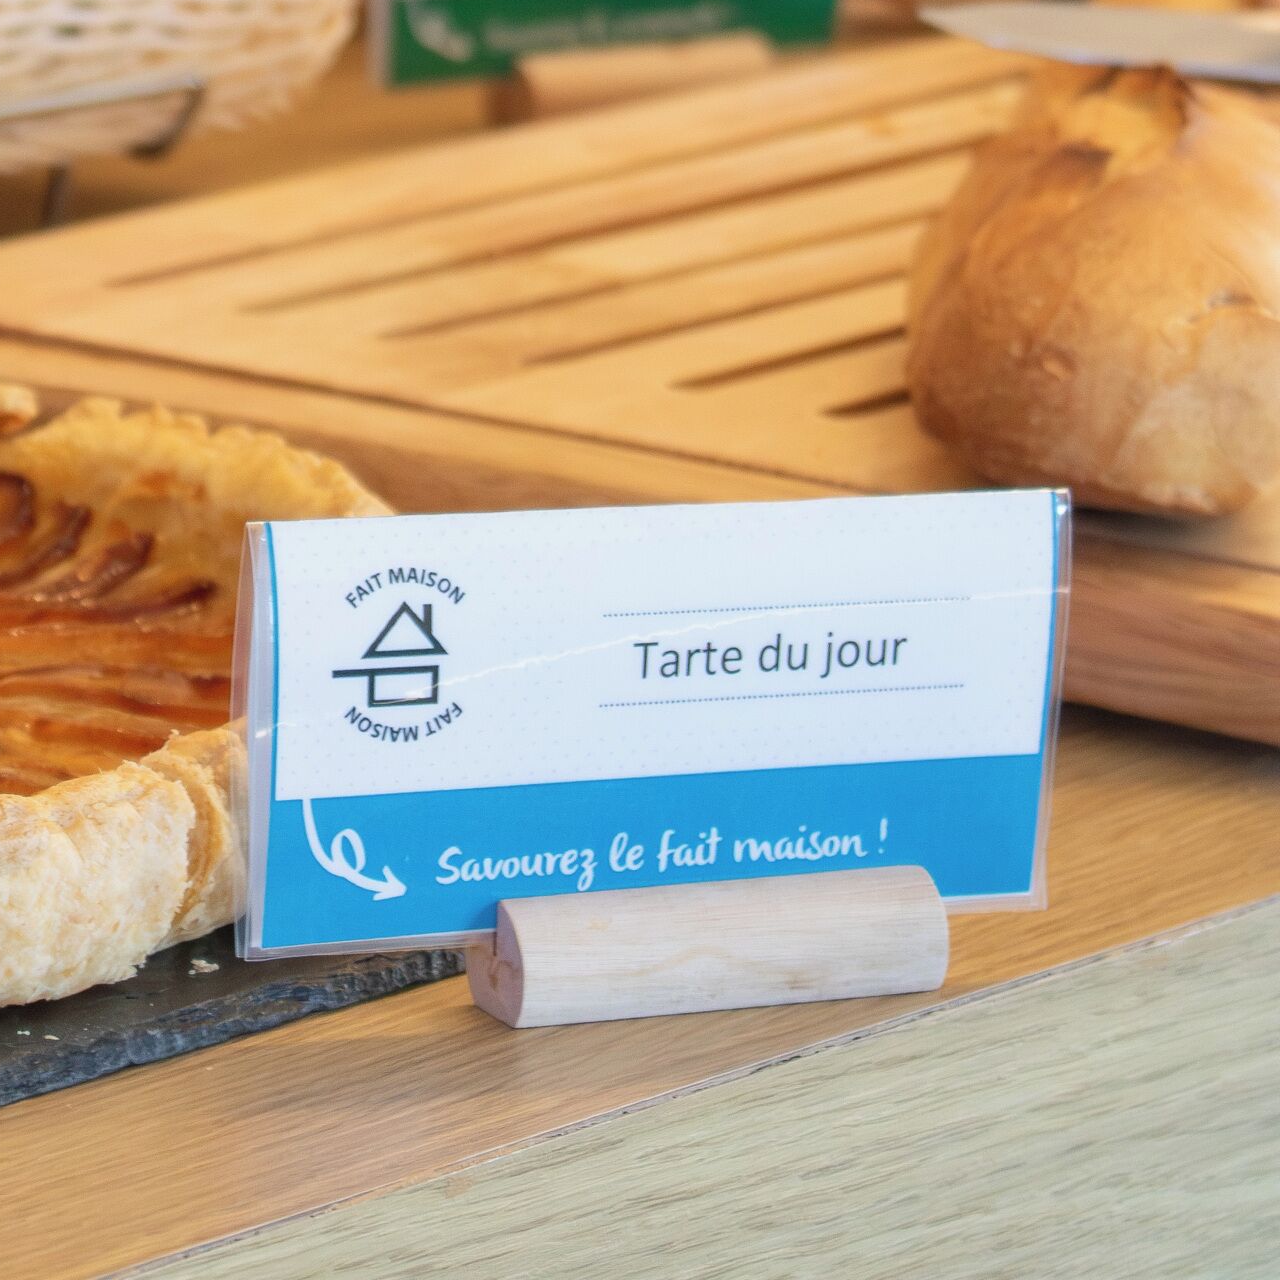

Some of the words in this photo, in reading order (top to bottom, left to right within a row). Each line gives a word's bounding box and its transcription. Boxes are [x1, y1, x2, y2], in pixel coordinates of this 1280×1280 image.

[345, 572, 383, 609] FAIT
[388, 567, 466, 605] MAISON
[633, 641, 743, 679] Tarte
[758, 633, 808, 672] du
[819, 631, 908, 678] jour
[344, 706, 419, 743] MAISON
[425, 702, 463, 737] FAIT
[435, 846, 598, 892] Savourez
[608, 832, 645, 873] le
[656, 826, 723, 873] fait
[732, 825, 868, 862] maison
